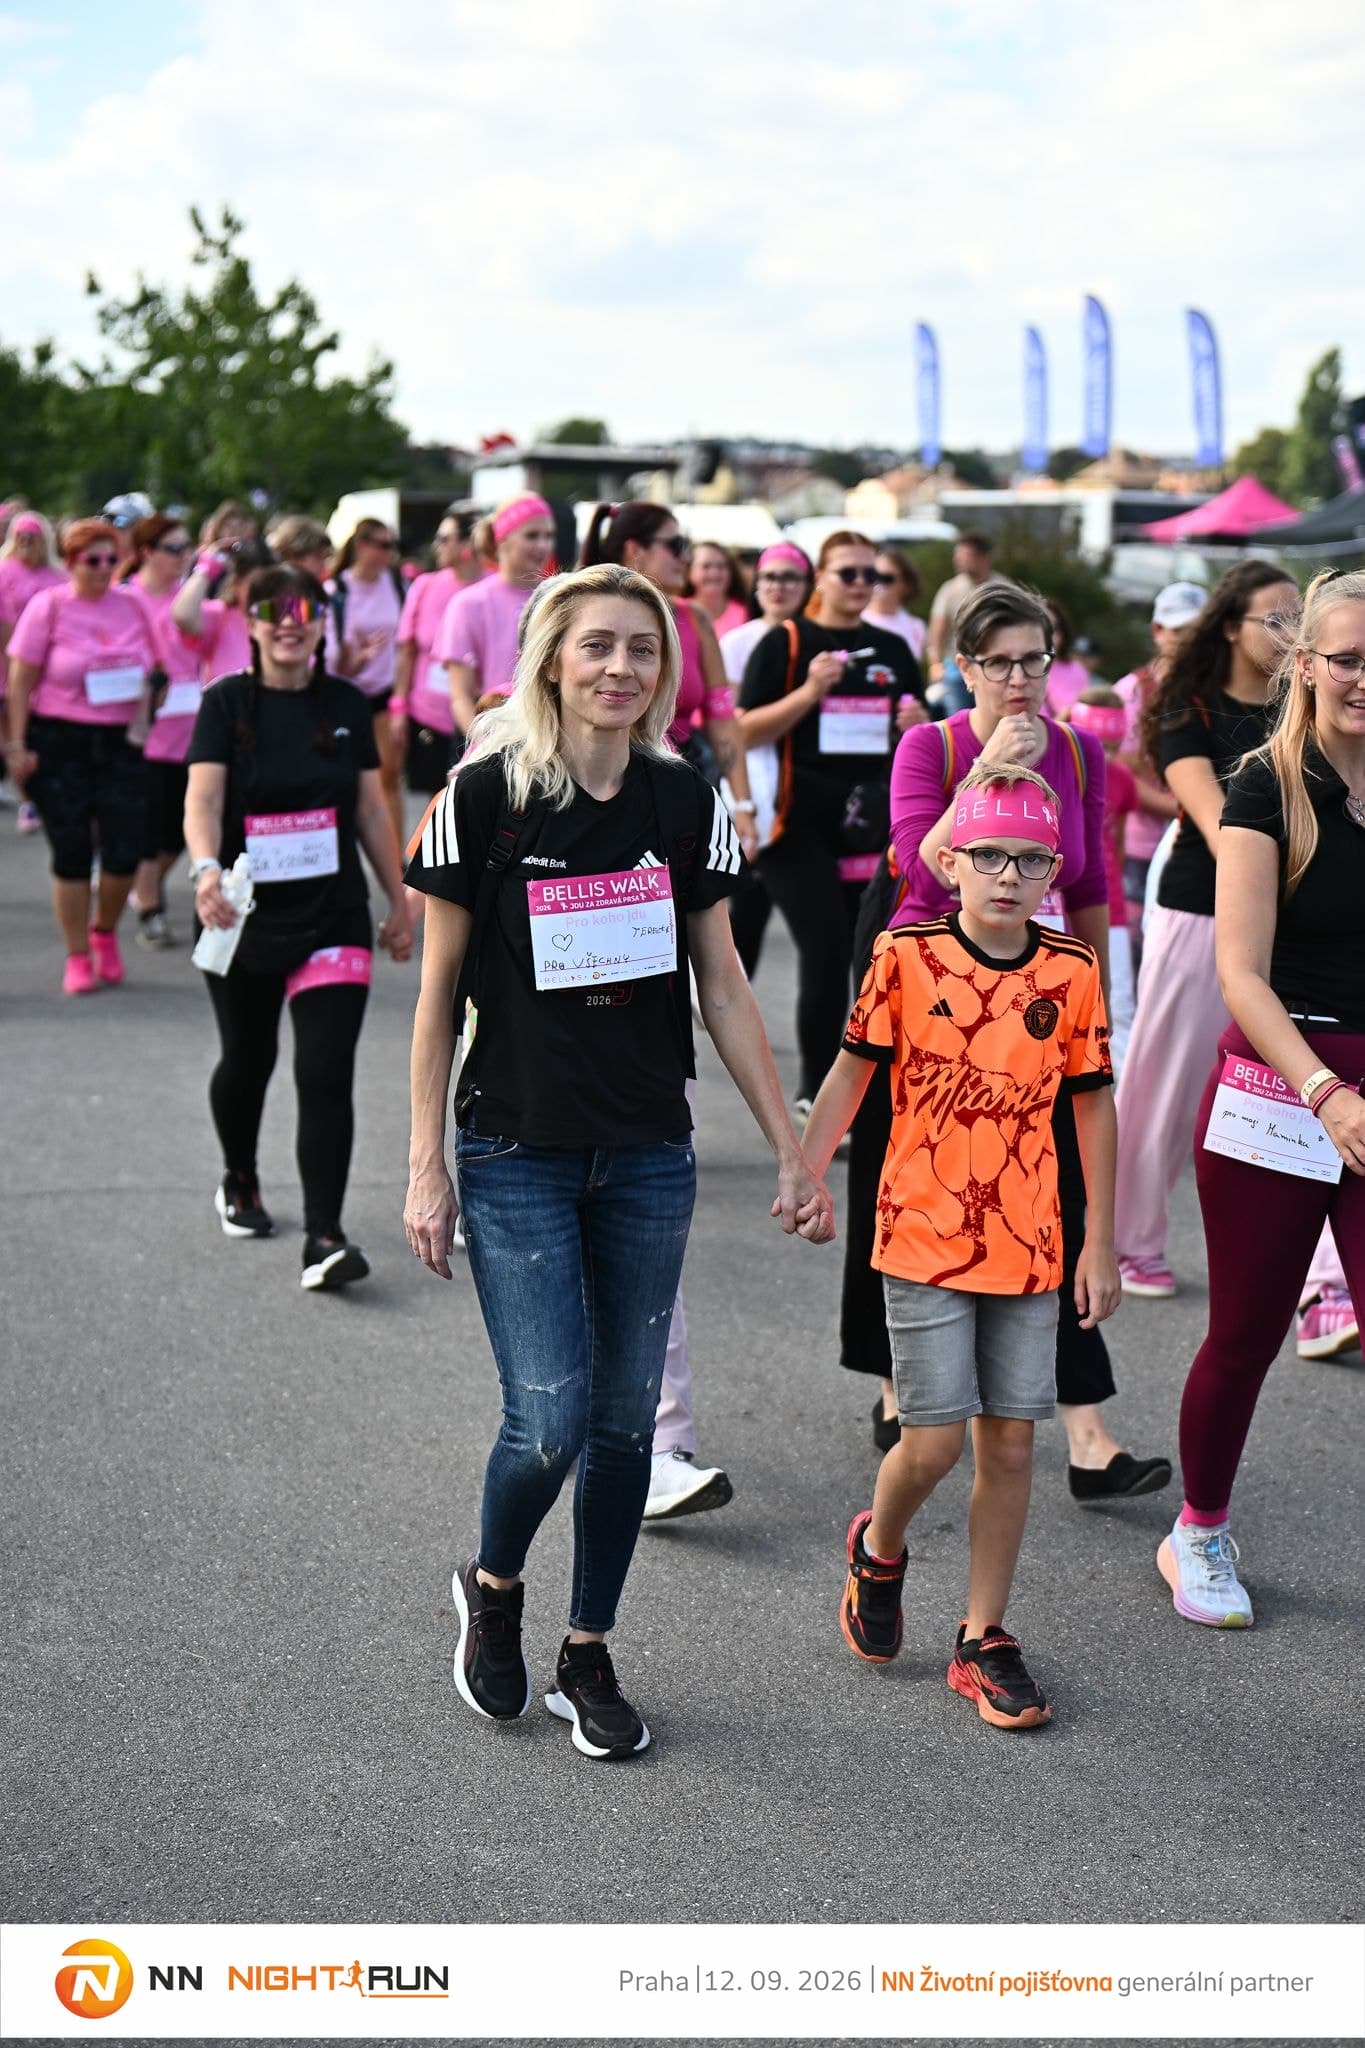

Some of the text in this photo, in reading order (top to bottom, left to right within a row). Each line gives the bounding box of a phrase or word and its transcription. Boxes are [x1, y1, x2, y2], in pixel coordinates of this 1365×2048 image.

[549, 858, 567, 869] Bank
[542, 872, 660, 902] BELLIS WALK
[535, 904, 552, 912] 2026
[570, 894, 640, 910] JDU ZA ZDRAVÁ PRSA
[565, 915, 589, 929] Pro
[592, 910, 624, 926] koho
[586, 995, 611, 1006] 2026
[1233, 1063, 1287, 1091] BELLIS
[906, 1063, 1053, 1135] Miami
[1251, 1086, 1265, 1095] JDU
[1264, 1089, 1274, 1098] ZA
[1243, 1096, 1264, 1111] Pro
[1266, 1103, 1298, 1121] koho
